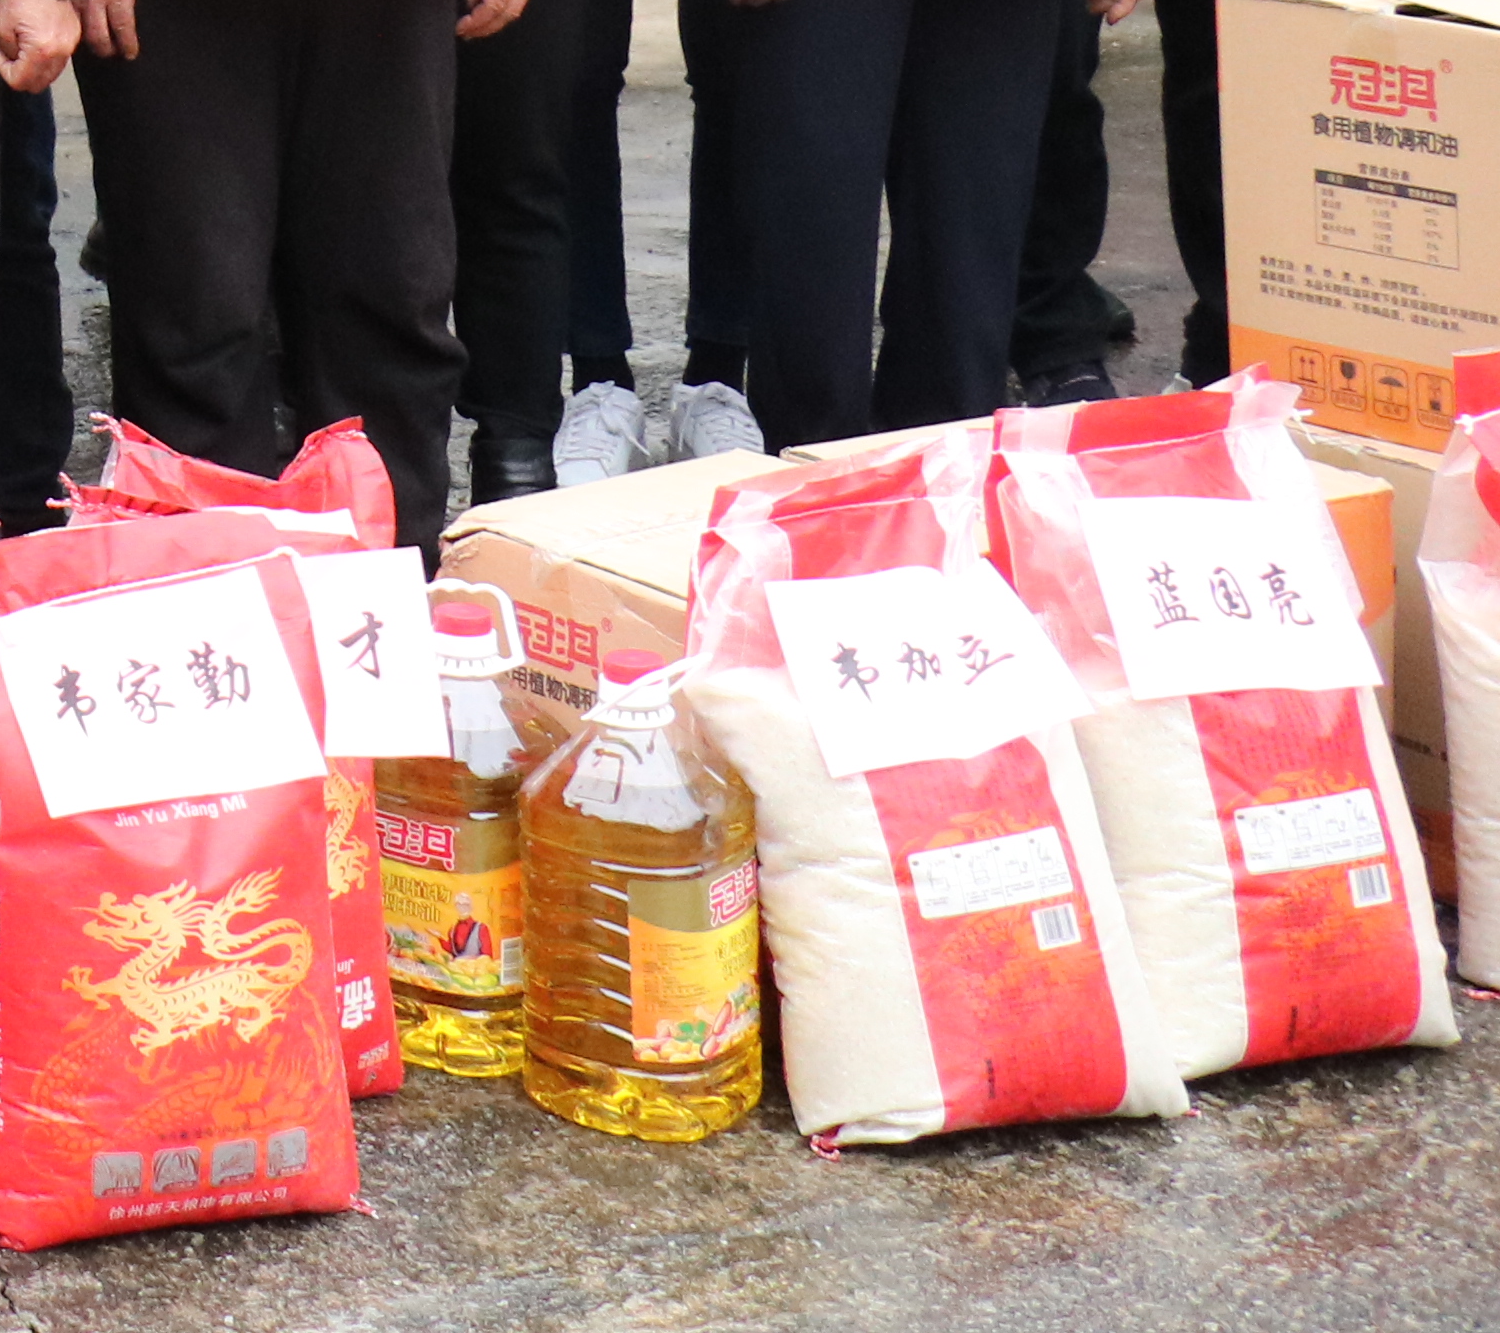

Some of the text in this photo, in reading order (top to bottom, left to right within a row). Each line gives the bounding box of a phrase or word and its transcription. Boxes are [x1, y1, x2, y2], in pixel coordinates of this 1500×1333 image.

[1310, 112, 1459, 158] 食用植物调和油
[1145, 561, 1317, 631] 蓝国亮
[338, 610, 385, 681] 才
[830, 634, 1014, 703] 韦加立
[54, 639, 251, 738] 韦家勤
[113, 793, 248, 831] Jin Yu Xiang Mi
